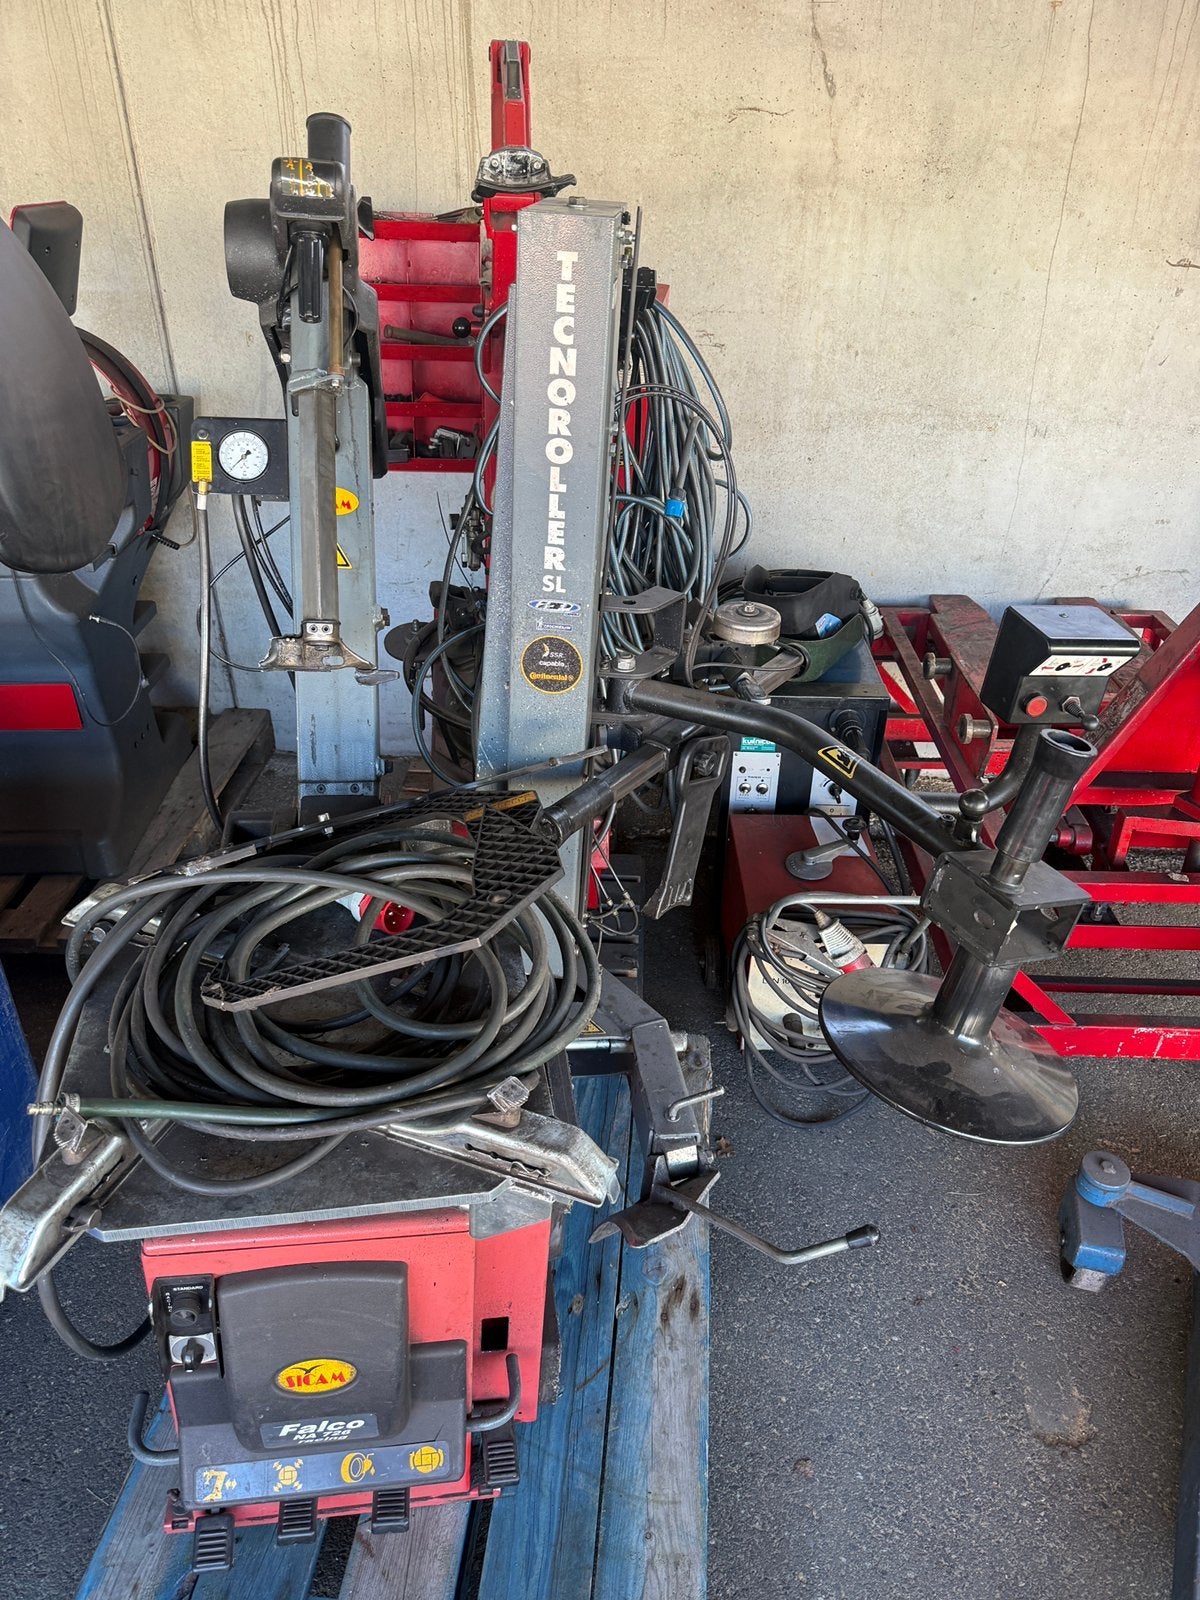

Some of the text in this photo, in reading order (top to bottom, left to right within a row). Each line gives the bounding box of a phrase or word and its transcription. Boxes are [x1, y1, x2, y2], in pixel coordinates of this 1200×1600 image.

[544, 250, 578, 571] TECNOROLLER
[541, 575, 566, 593] SL
[286, 1371, 347, 1388] SICAM
[279, 1420, 365, 1437] Falco
[293, 1433, 317, 1441] NA
